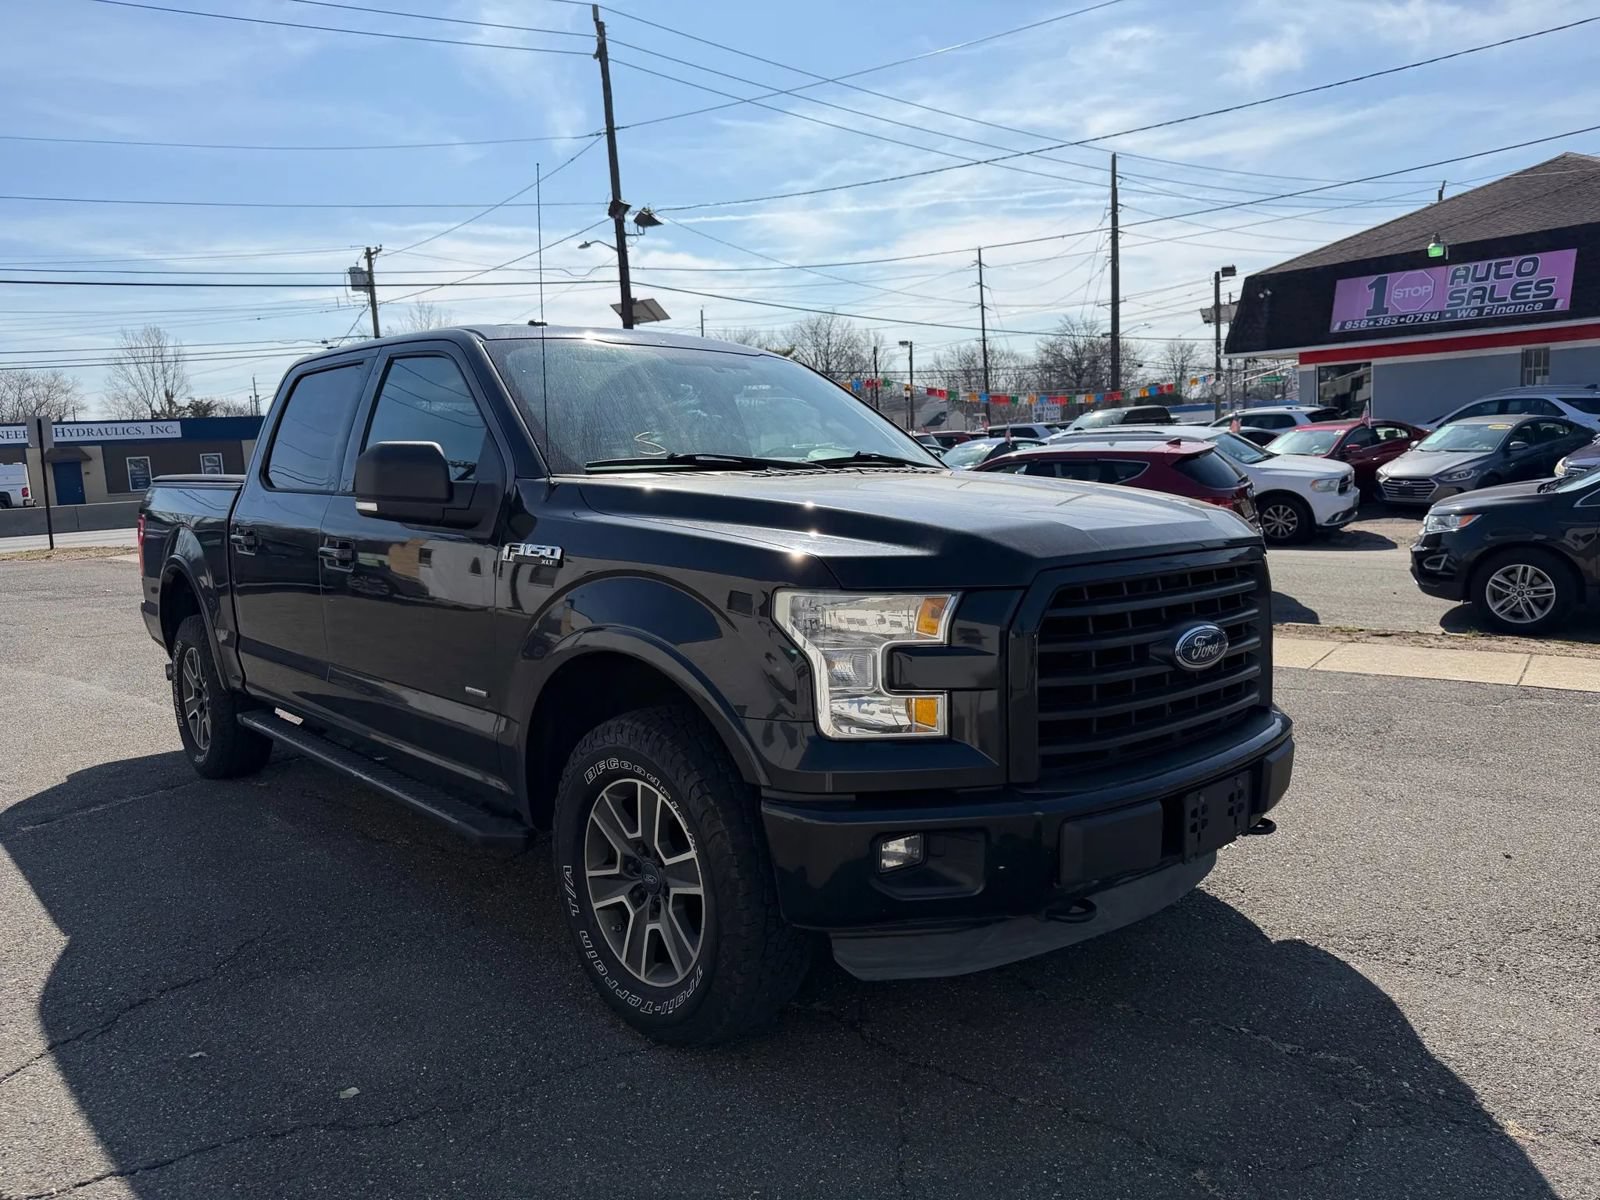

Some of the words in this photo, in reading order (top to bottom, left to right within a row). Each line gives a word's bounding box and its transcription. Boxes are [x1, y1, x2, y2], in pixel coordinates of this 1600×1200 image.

[1450, 256, 1540, 286] AUTO
[1365, 275, 1389, 317] 1
[1394, 286, 1431, 299] STOP
[1446, 277, 1556, 309] SALES
[1457, 308, 1478, 318] We
[1483, 302, 1544, 315] Finance
[0, 430, 28, 440] NEE
[54, 425, 145, 439] HYDRAULICS,
[150, 425, 177, 436] INC.
[1192, 635, 1219, 660] Ford
